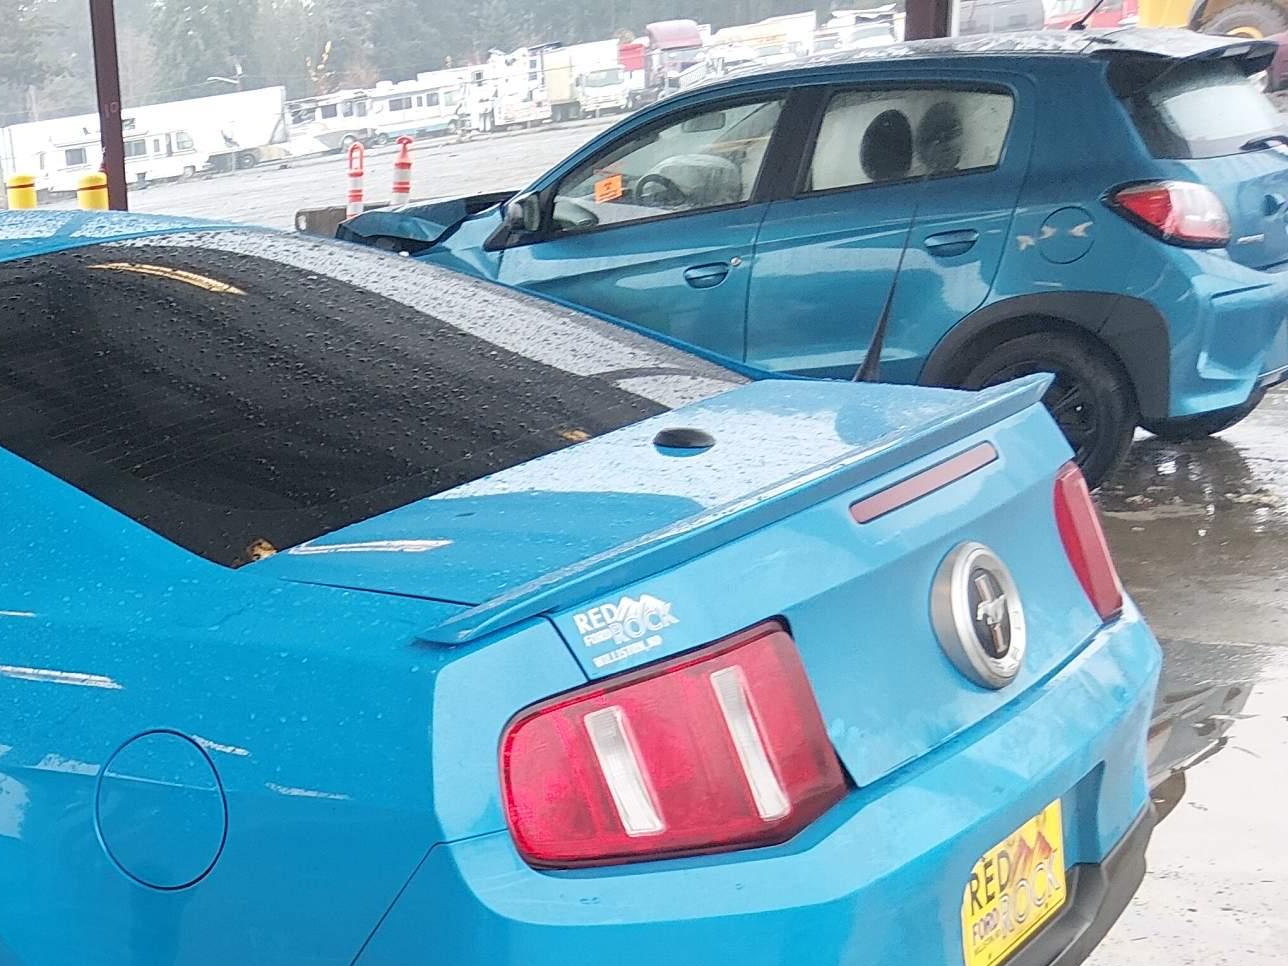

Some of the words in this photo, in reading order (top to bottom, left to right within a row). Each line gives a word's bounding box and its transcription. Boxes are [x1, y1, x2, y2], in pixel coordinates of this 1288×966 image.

[573, 603, 617, 634] RED
[608, 603, 680, 643] ROCK
[970, 850, 1010, 916] RED
[999, 849, 1062, 939] ROCK
[973, 908, 999, 946] FORD
